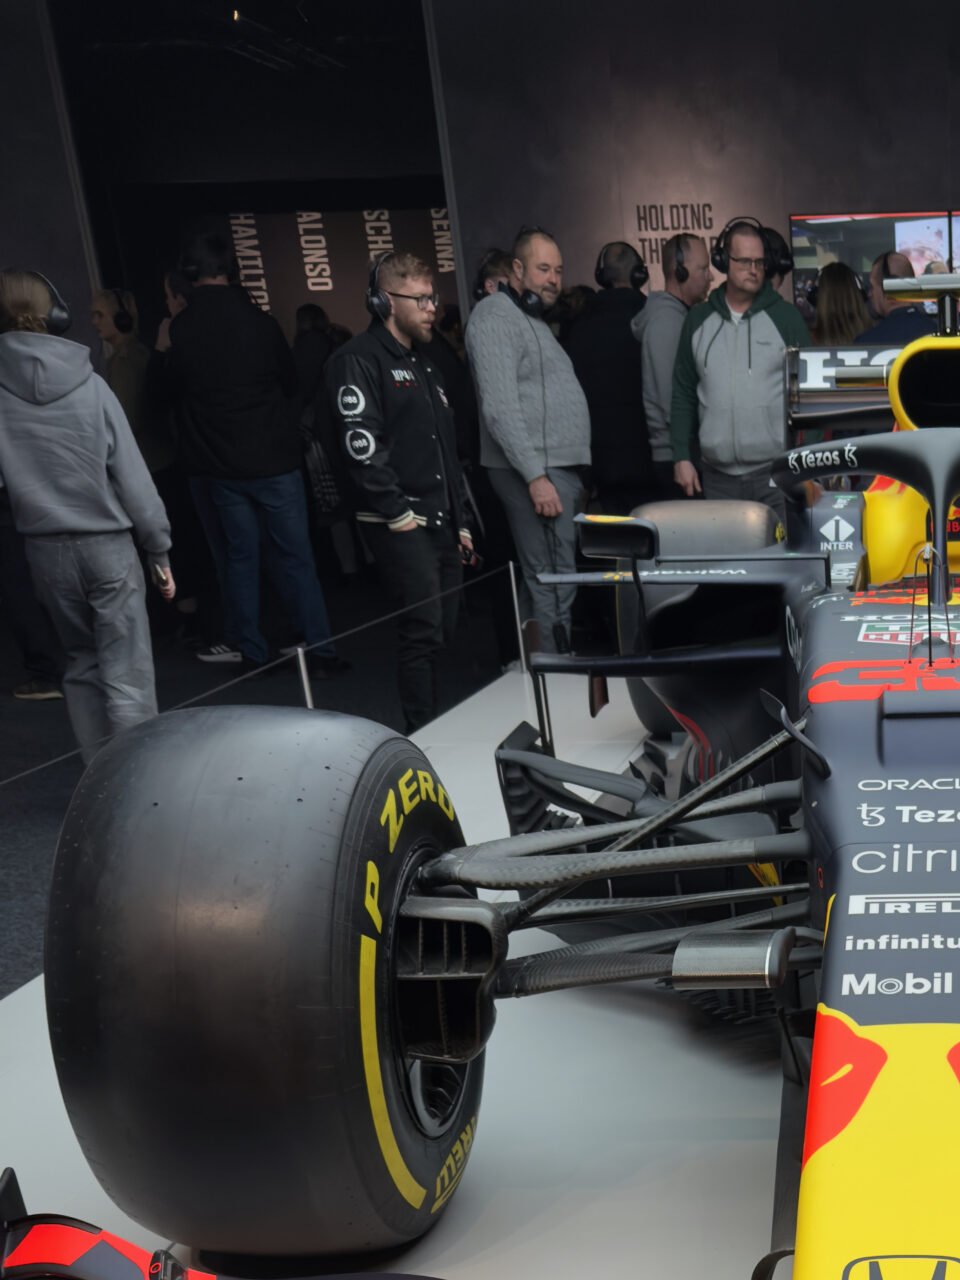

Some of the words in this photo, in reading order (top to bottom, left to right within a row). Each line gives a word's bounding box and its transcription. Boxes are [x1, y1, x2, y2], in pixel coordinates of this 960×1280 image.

[430, 208, 455, 273] SENNA
[636, 203, 713, 232] HOLDING
[229, 213, 272, 315] HAMILTO
[296, 211, 333, 291] ALONSO
[801, 449, 840, 469] Tezos
[820, 541, 854, 551] INTER
[364, 860, 382, 934] P
[380, 768, 454, 854] ZERO
[841, 972, 953, 996] Mobil
[430, 1116, 478, 1214] IRELLI
